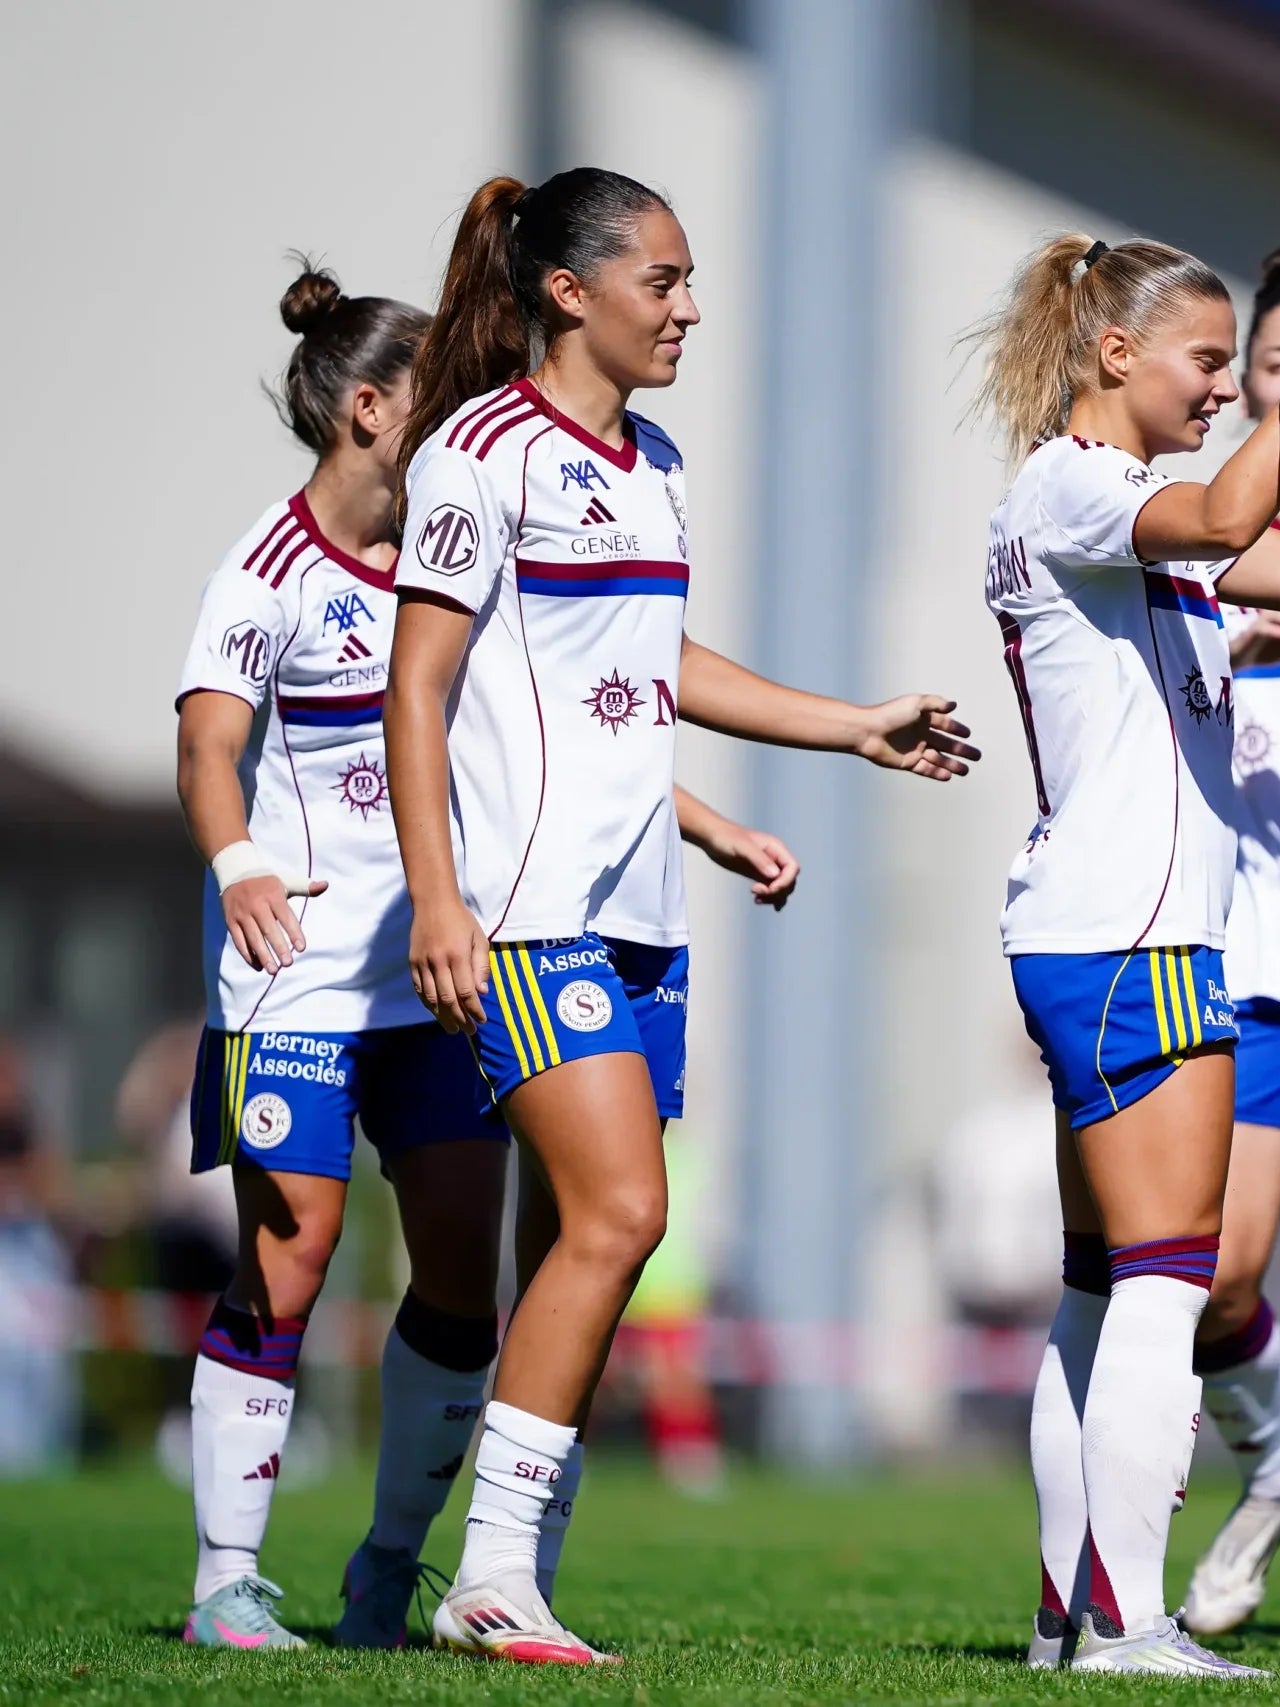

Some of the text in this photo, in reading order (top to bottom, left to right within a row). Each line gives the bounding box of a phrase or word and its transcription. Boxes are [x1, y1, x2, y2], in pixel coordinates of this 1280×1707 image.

[560, 459, 612, 492] AXA
[422, 511, 475, 570] MG
[321, 592, 377, 638] AXA
[562, 983, 603, 1001] SERVETTE
[576, 993, 595, 1019] S
[260, 1032, 345, 1064] Berney
[248, 1052, 347, 1087] Associés
[257, 1107, 273, 1134] S
[245, 1398, 288, 1417] SFC
[513, 1460, 561, 1484] SFC
[543, 1499, 573, 1518] FC
